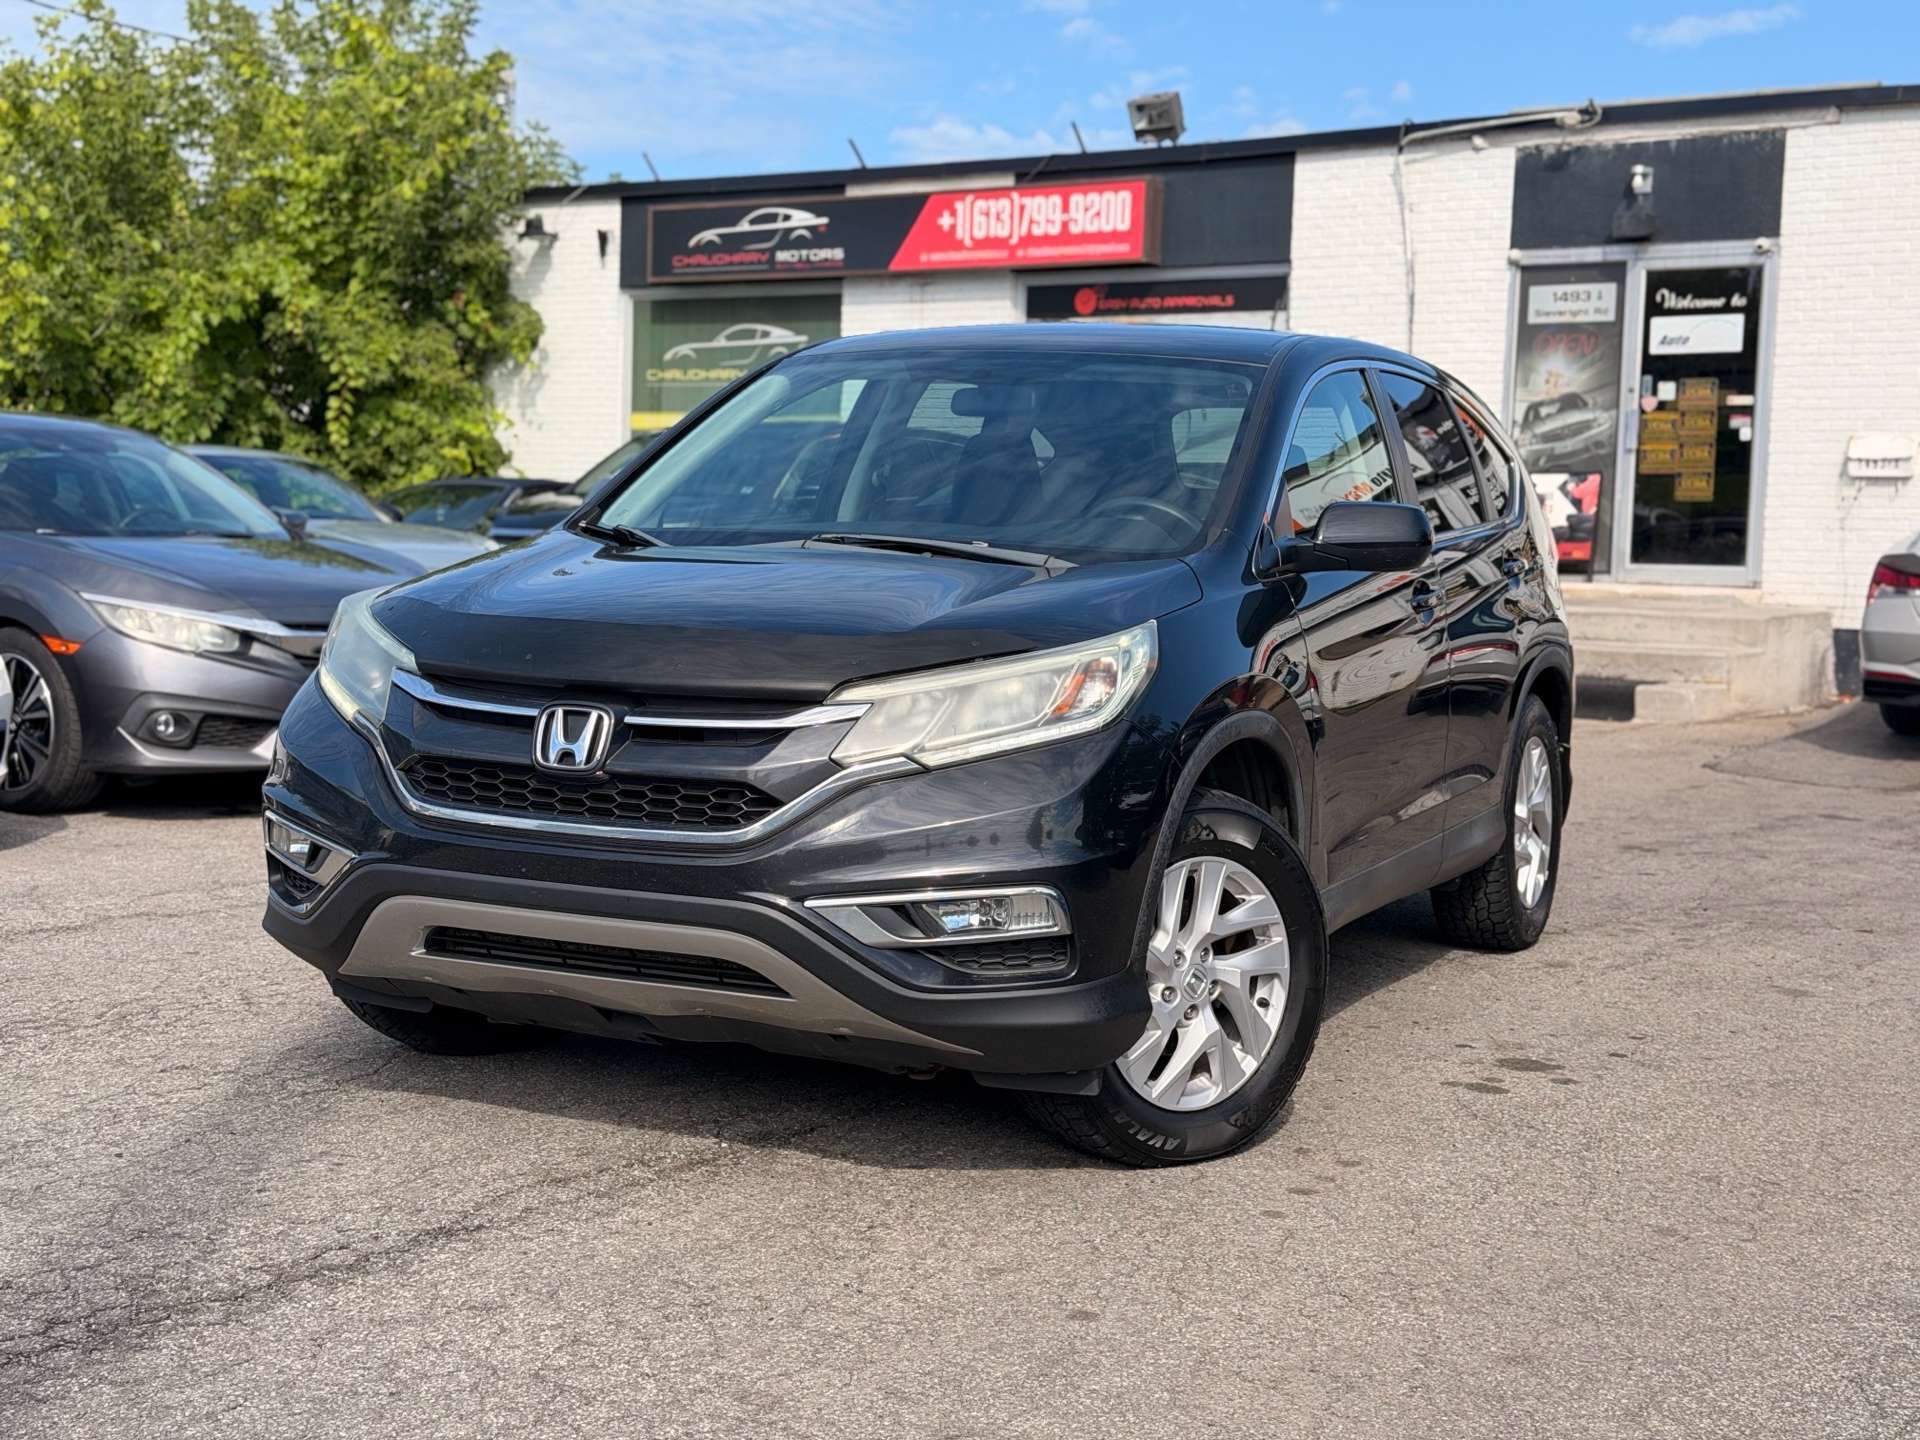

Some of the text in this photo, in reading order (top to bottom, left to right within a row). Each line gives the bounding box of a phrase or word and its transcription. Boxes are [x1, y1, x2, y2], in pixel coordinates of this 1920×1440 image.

[936, 190, 1133, 248] +1(613)799-9200
[774, 247, 846, 263] MOTORS
[1655, 287, 1748, 310] Welcome to
